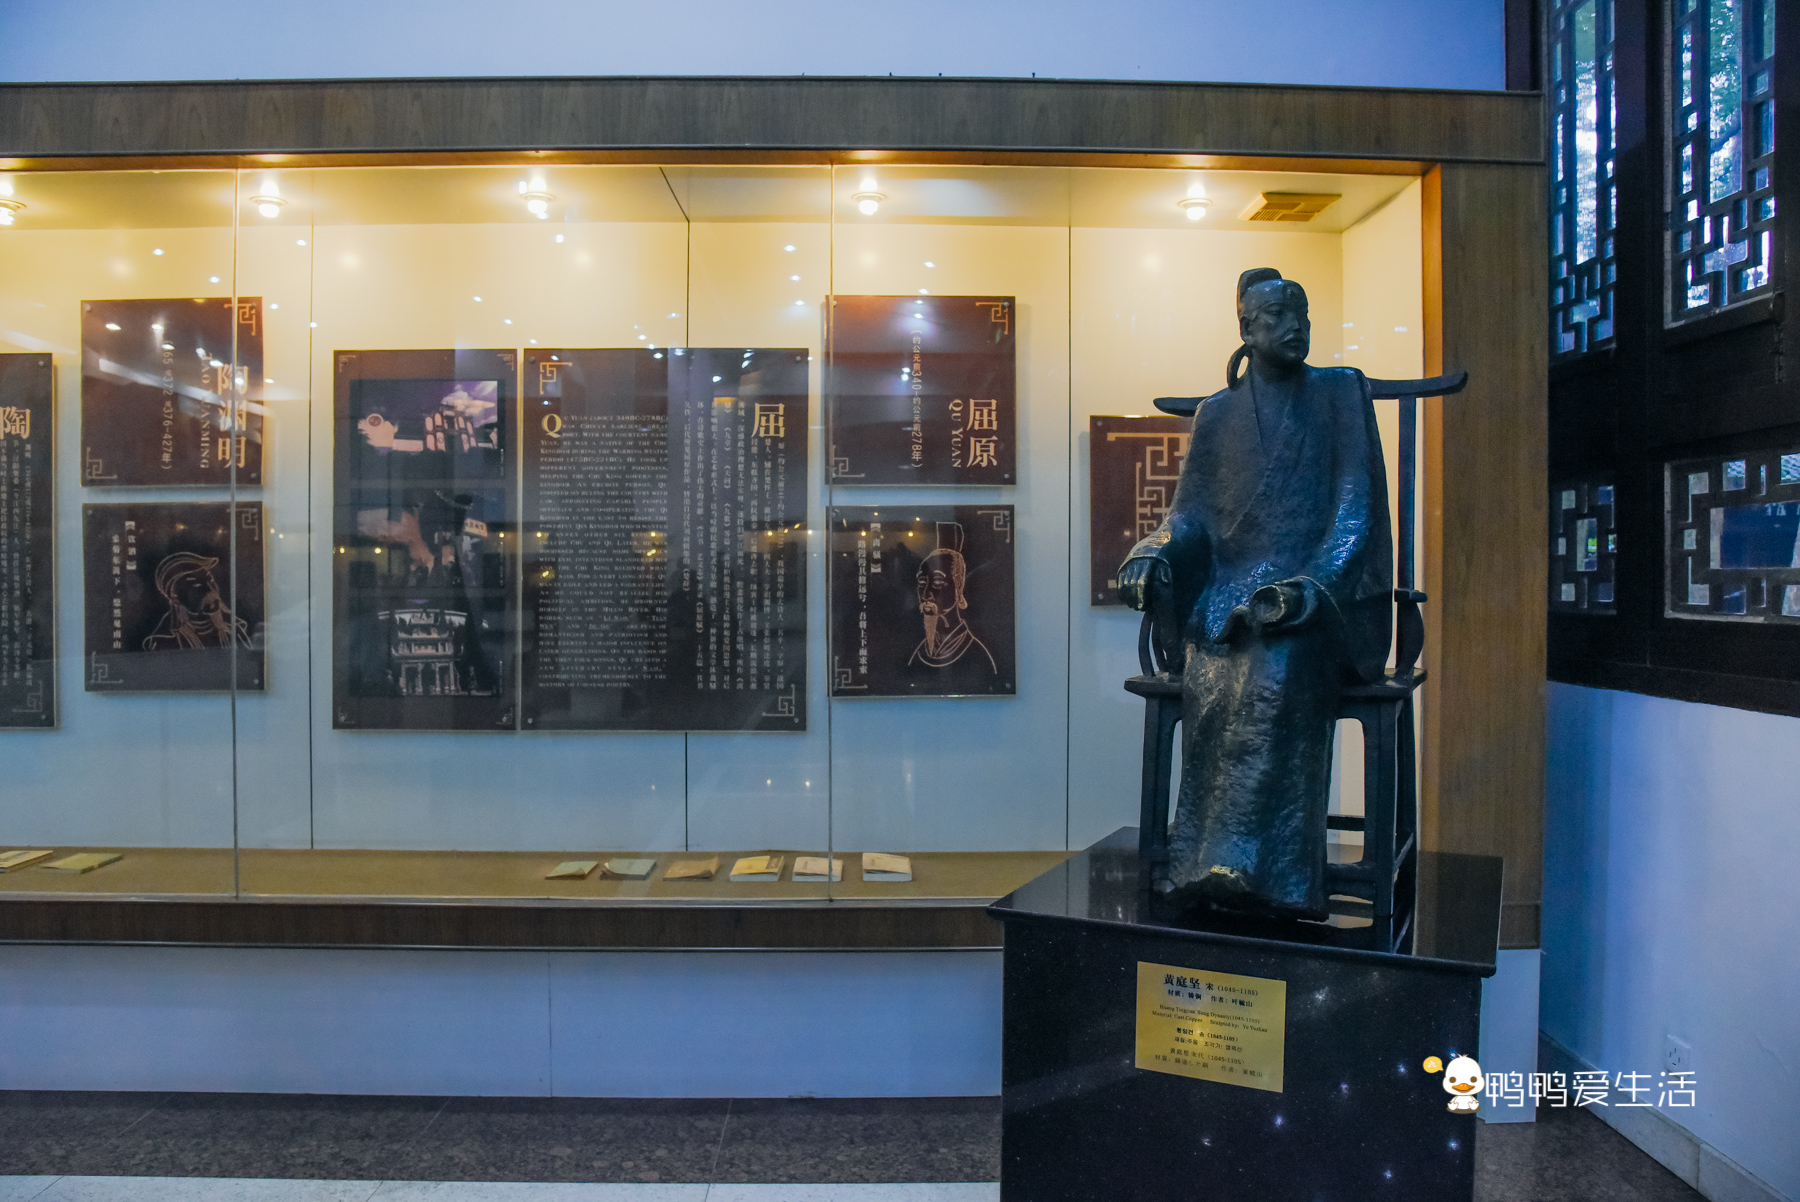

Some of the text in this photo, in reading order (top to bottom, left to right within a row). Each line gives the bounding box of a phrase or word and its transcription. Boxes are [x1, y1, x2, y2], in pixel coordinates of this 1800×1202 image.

[948, 399, 963, 468] QU YUAN
[966, 398, 999, 468] 屈原
[1163, 973, 1201, 990] 黄庭坚
[1205, 982, 1214, 991] 宋
